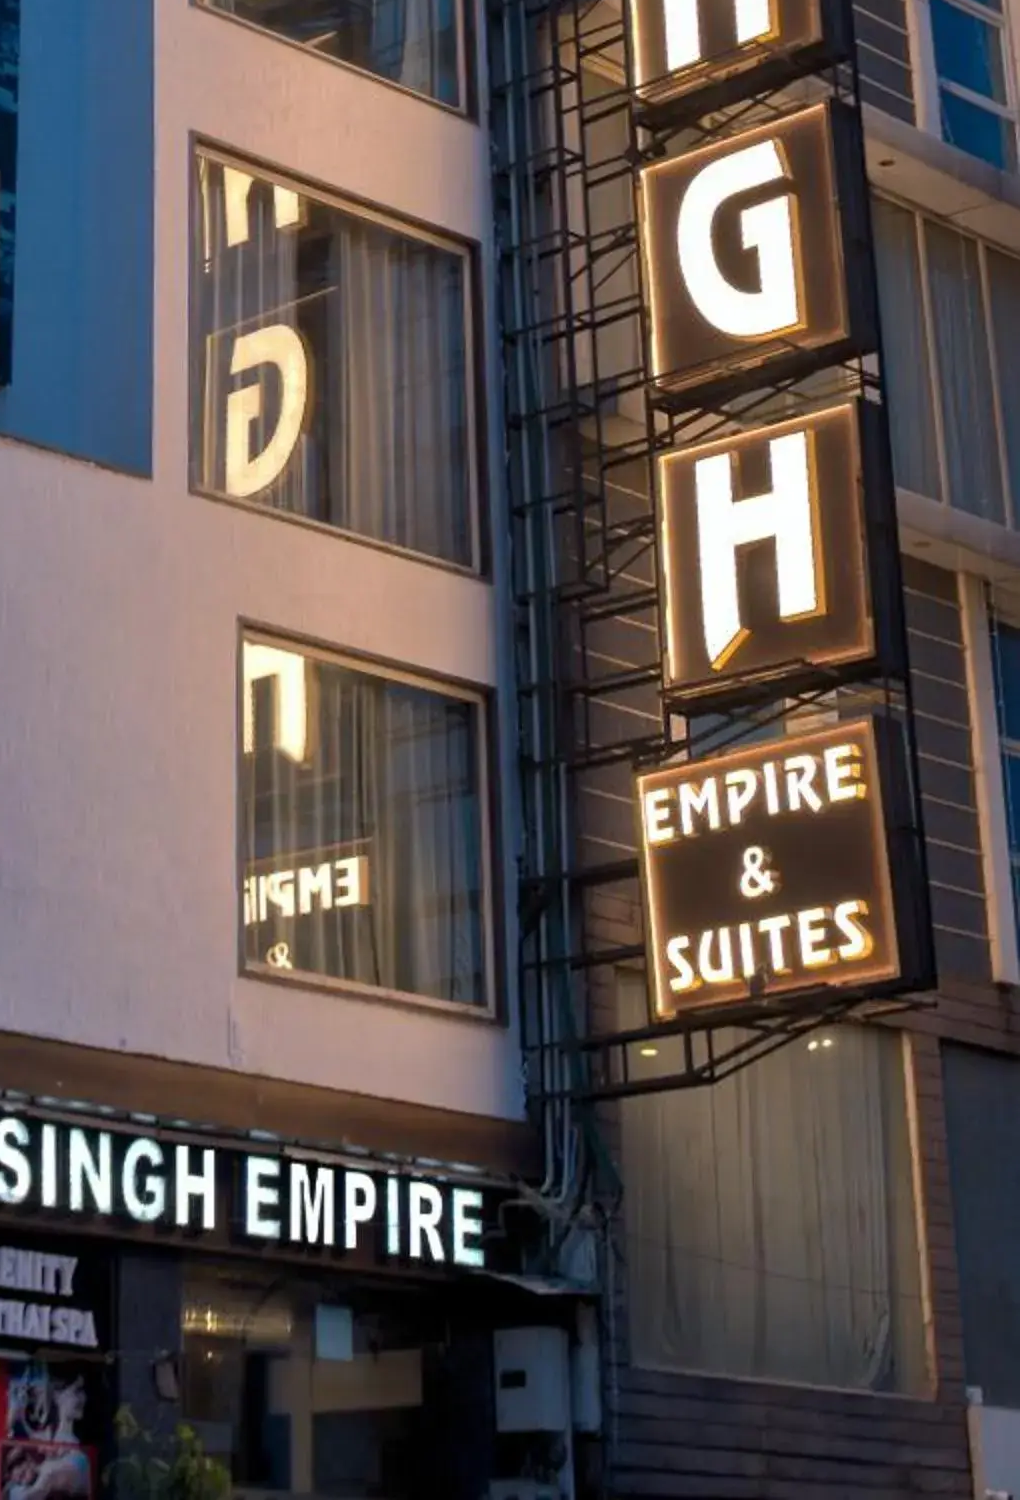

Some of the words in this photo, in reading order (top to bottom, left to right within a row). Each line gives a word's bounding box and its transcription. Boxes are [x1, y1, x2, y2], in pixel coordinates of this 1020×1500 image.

[643, 744, 866, 844] EMPIRE
[739, 845, 776, 898] &
[666, 900, 872, 992] SUITES
[244, 1154, 486, 1268] EMPIRE
[51, 1305, 98, 1347] SPA
